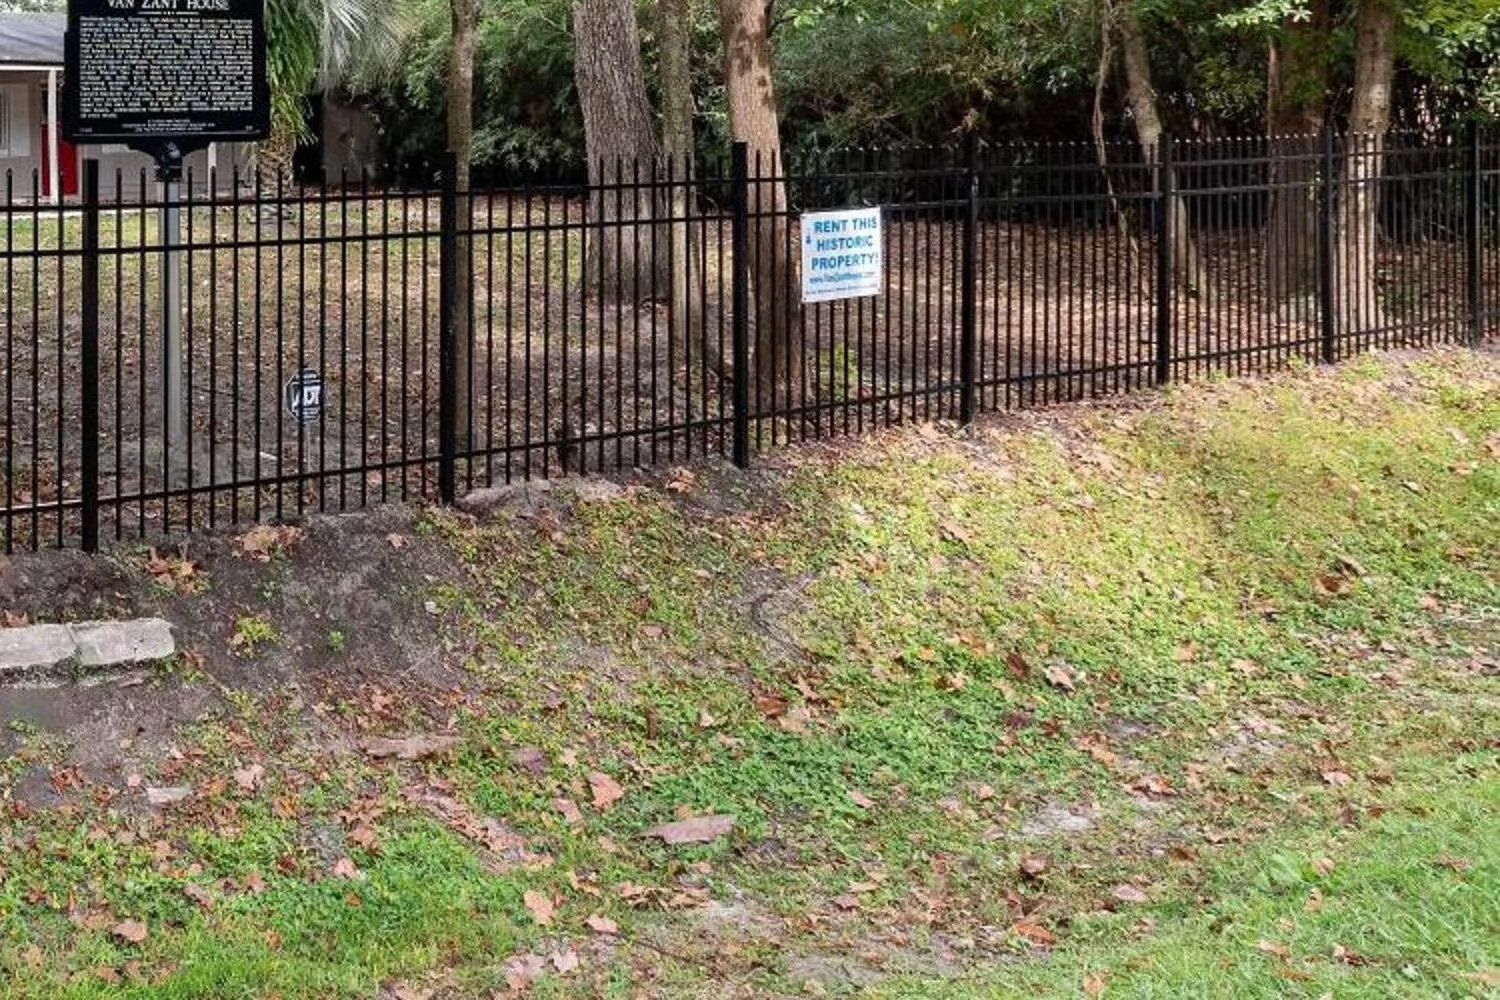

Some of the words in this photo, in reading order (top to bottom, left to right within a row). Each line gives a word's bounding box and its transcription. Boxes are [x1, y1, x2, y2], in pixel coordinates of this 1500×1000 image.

[813, 219, 849, 234] RENT
[852, 216, 878, 230] THIS
[816, 235, 873, 252] HISTORIC
